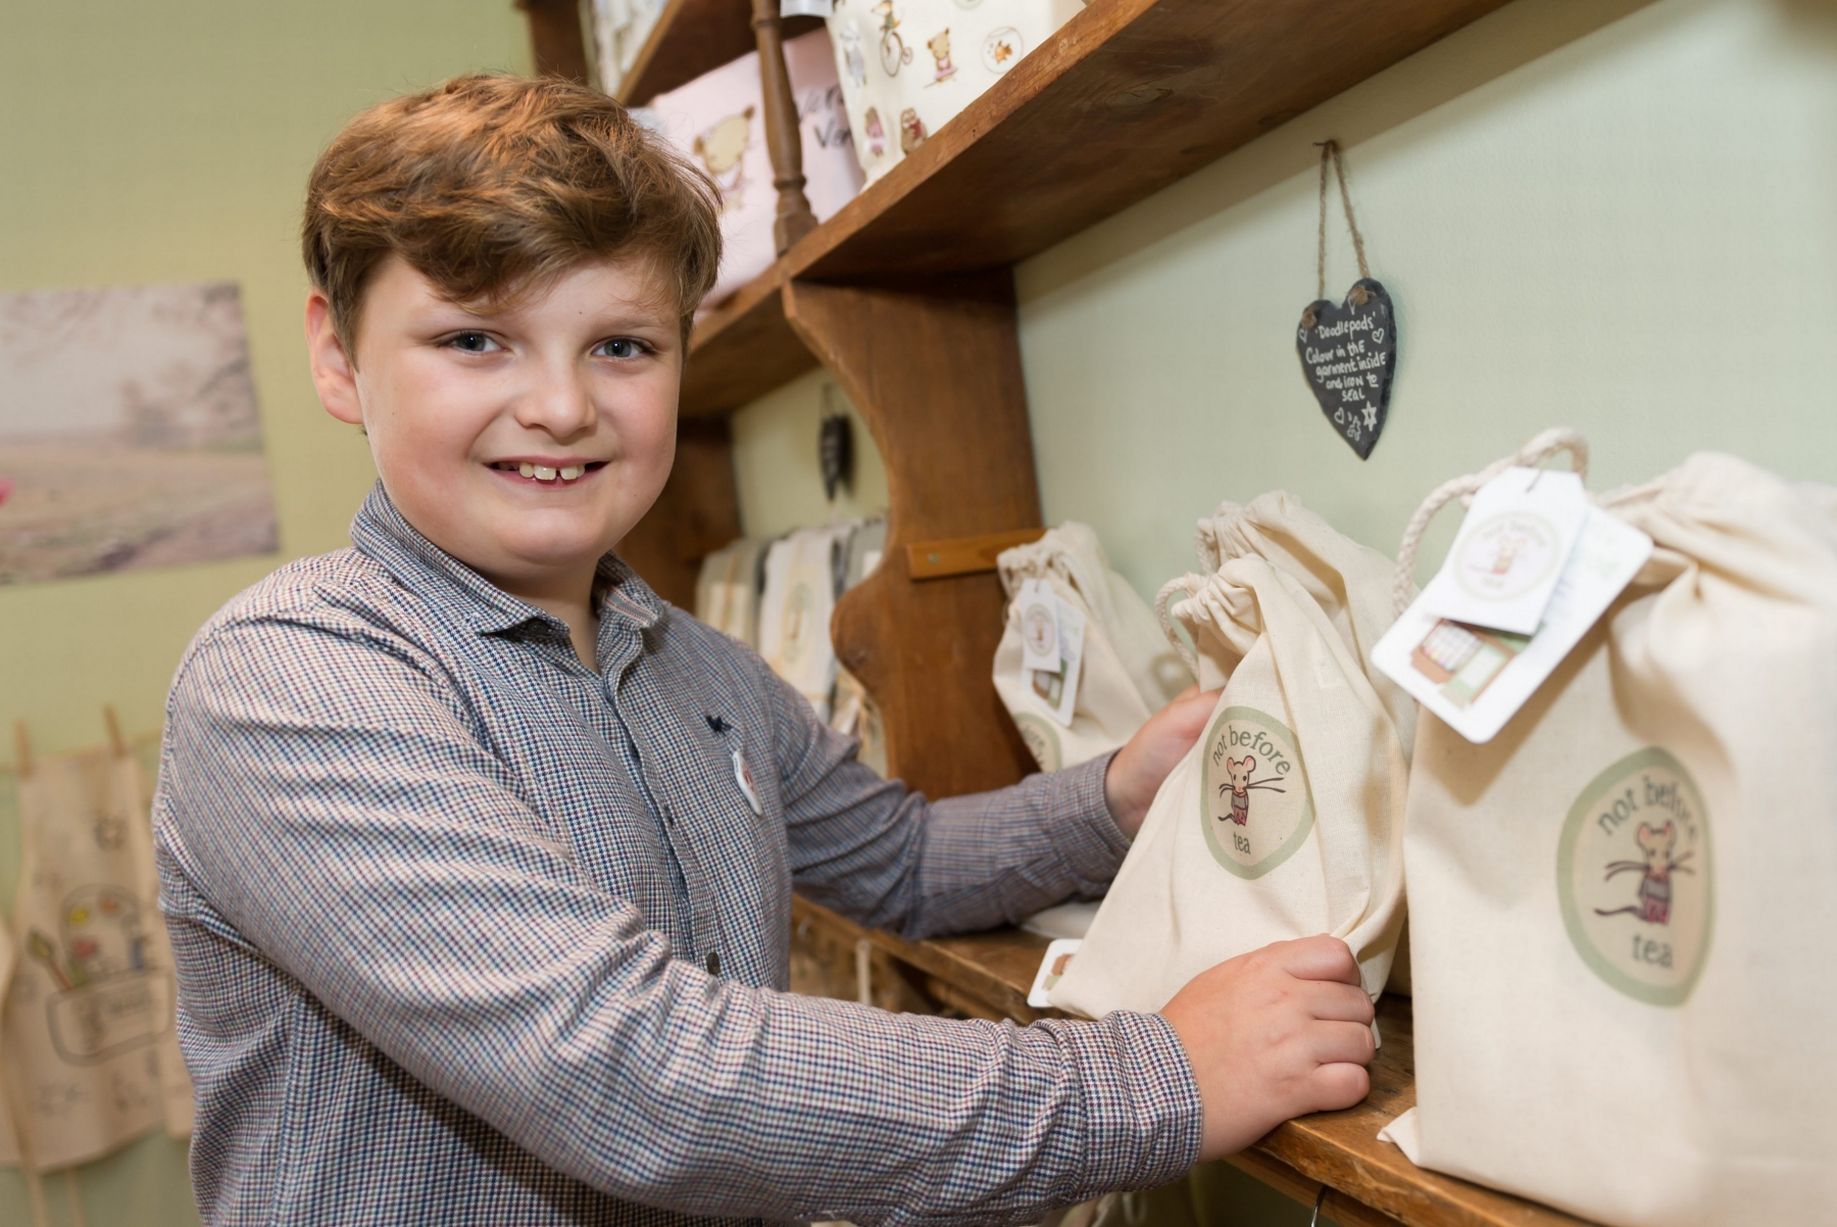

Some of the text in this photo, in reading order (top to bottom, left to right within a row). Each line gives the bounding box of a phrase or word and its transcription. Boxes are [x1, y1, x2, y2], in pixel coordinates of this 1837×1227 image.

[1305, 346, 1334, 364] Colour
[1336, 344, 1346, 357] in
[1315, 358, 1358, 383] garment
[1325, 377, 1343, 389] and
[1212, 725, 1291, 775] not before
[1598, 788, 1639, 836] not
[1233, 832, 1251, 855] tea
[1632, 934, 1673, 968] tea
